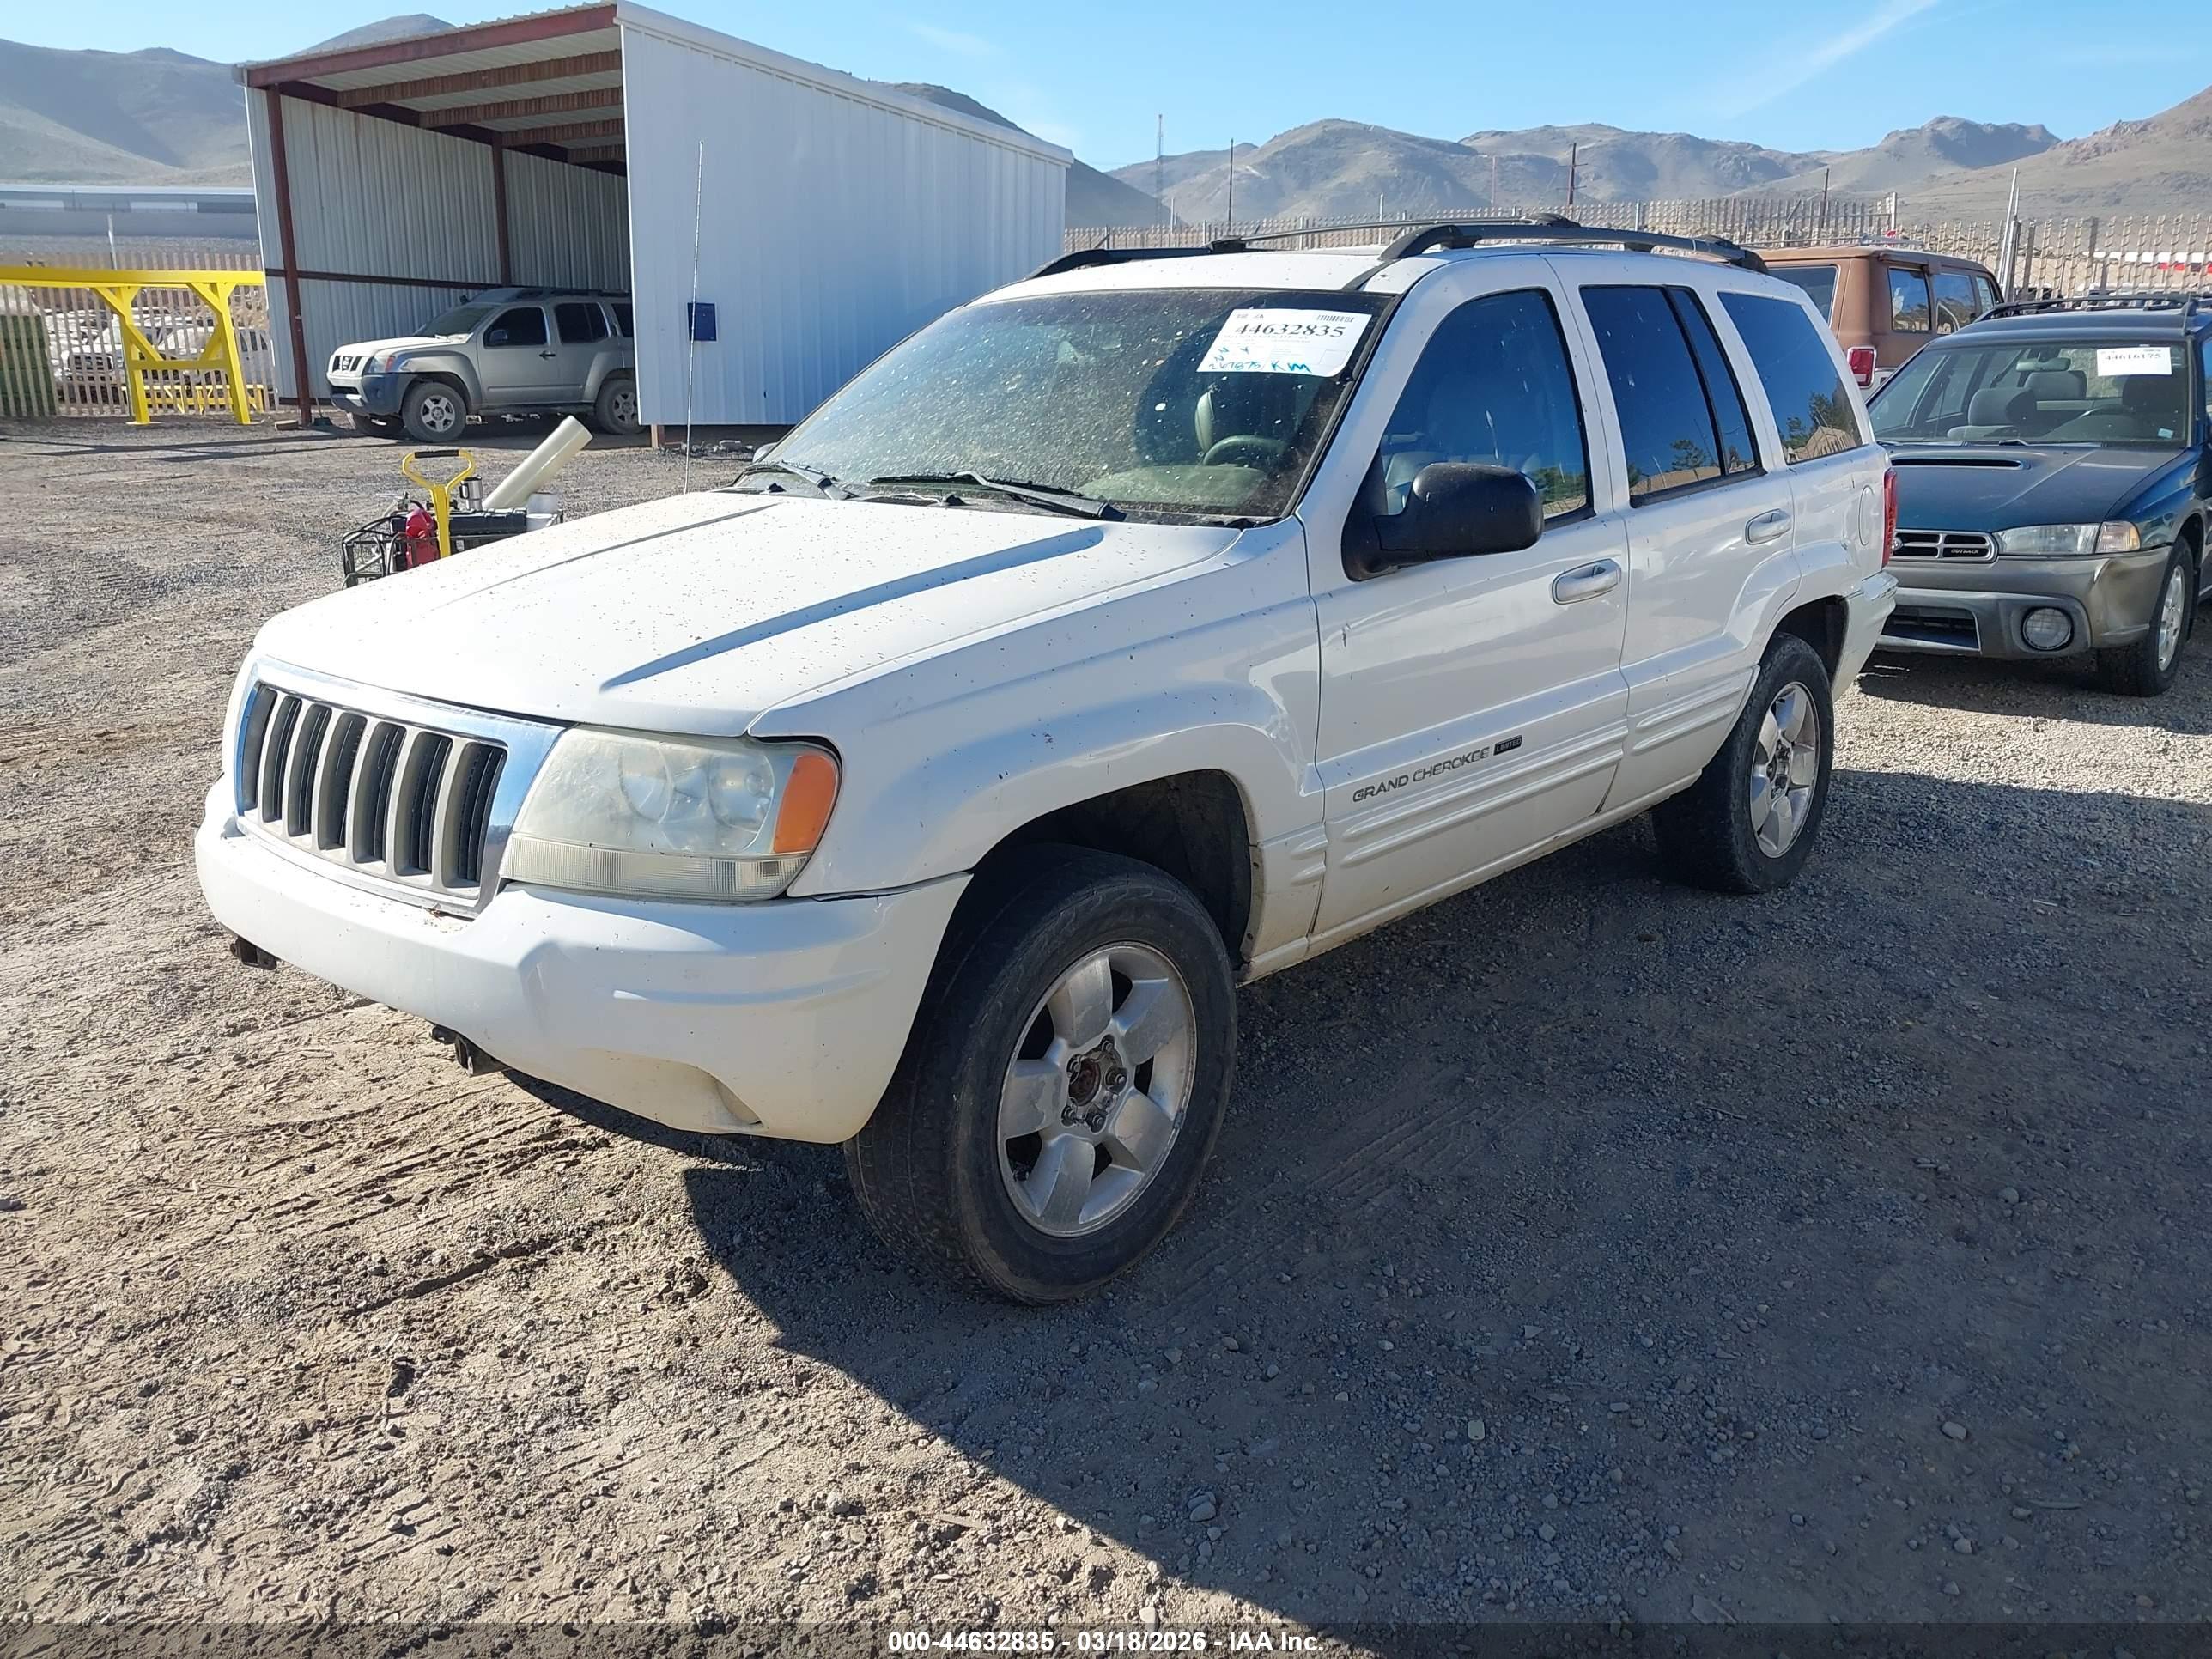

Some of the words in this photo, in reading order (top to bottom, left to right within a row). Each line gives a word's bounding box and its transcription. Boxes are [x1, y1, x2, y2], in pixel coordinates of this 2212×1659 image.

[1235, 323, 1346, 337] 44632835
[1352, 775, 1409, 802] GRAND
[1413, 747, 1490, 782] CHEROKEE
